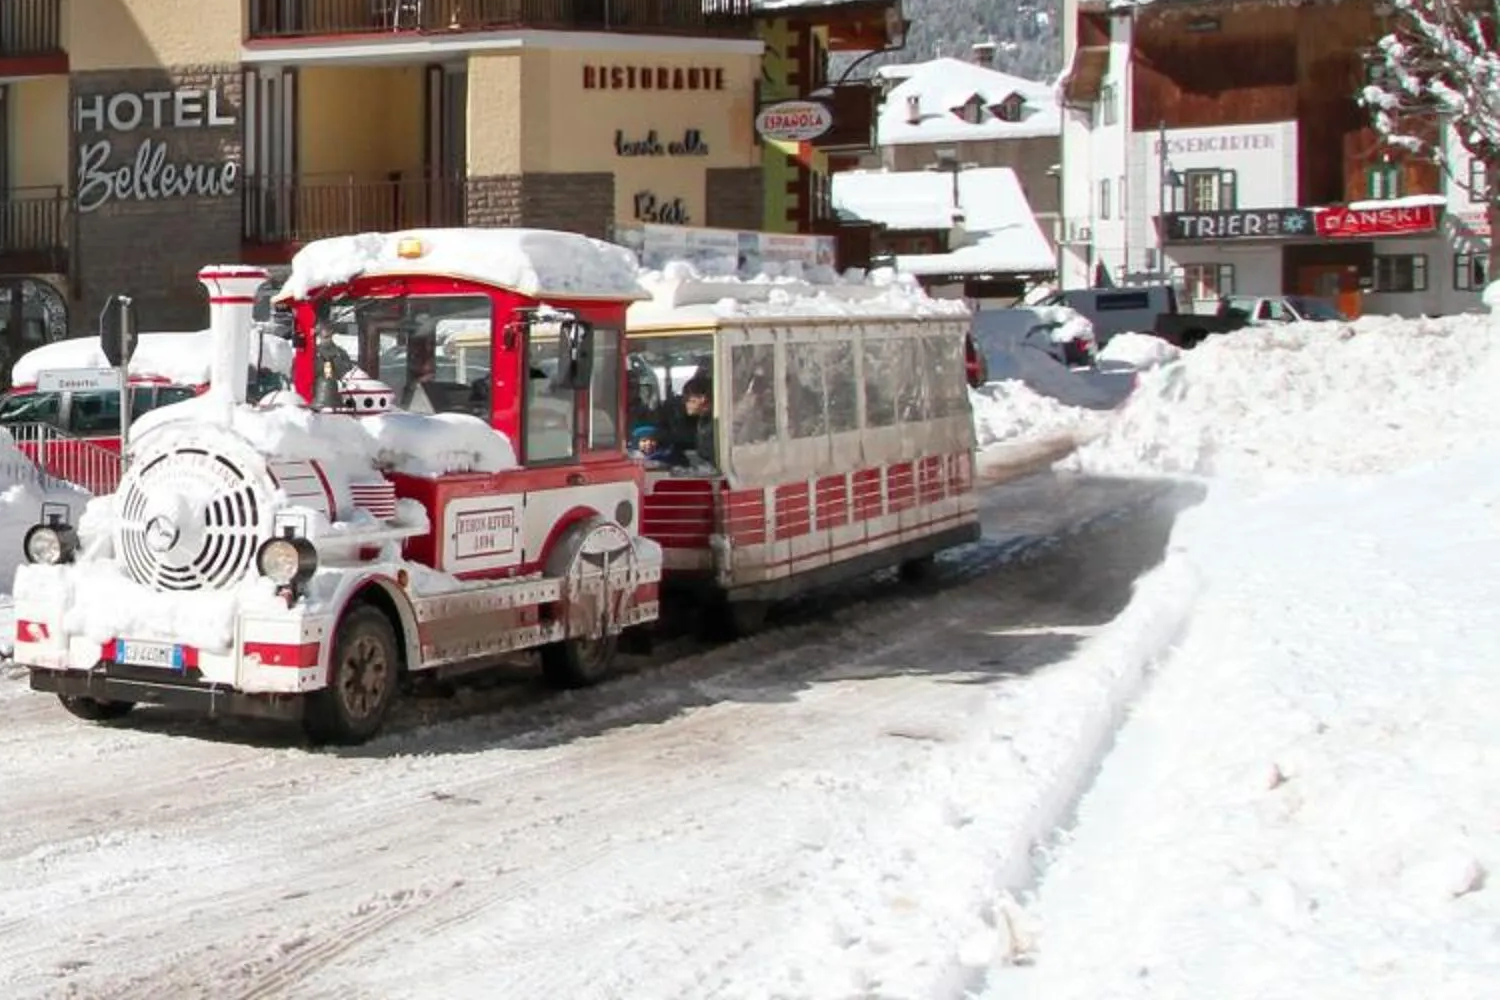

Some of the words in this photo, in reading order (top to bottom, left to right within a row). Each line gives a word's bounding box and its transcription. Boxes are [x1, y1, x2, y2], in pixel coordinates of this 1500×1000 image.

[583, 66, 725, 90] RISTORANTE
[76, 89, 236, 132] HOTEL
[78, 138, 237, 213] Bellevue
